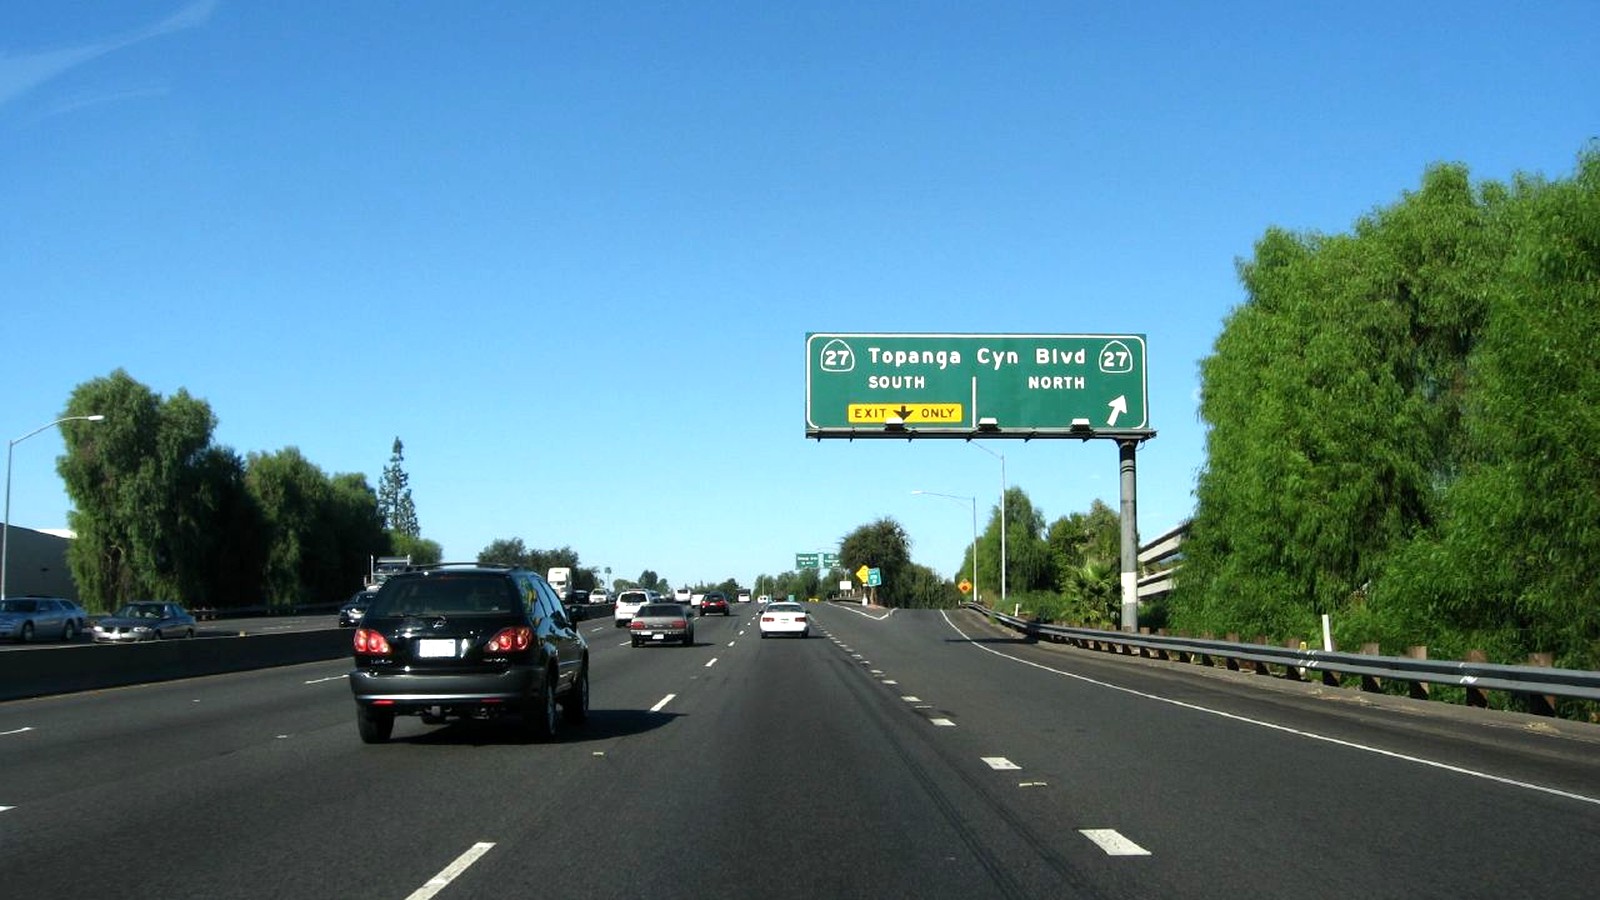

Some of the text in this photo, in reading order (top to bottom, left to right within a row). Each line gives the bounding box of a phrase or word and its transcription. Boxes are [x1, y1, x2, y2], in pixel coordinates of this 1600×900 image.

[824, 350, 850, 366] 27
[868, 347, 1086, 370] Topanga Cyn Blvd
[1103, 351, 1129, 368] 27
[868, 376, 925, 389] SOUTH
[1028, 377, 1085, 390] NORTH
[854, 408, 955, 419] EXIT ONLY
